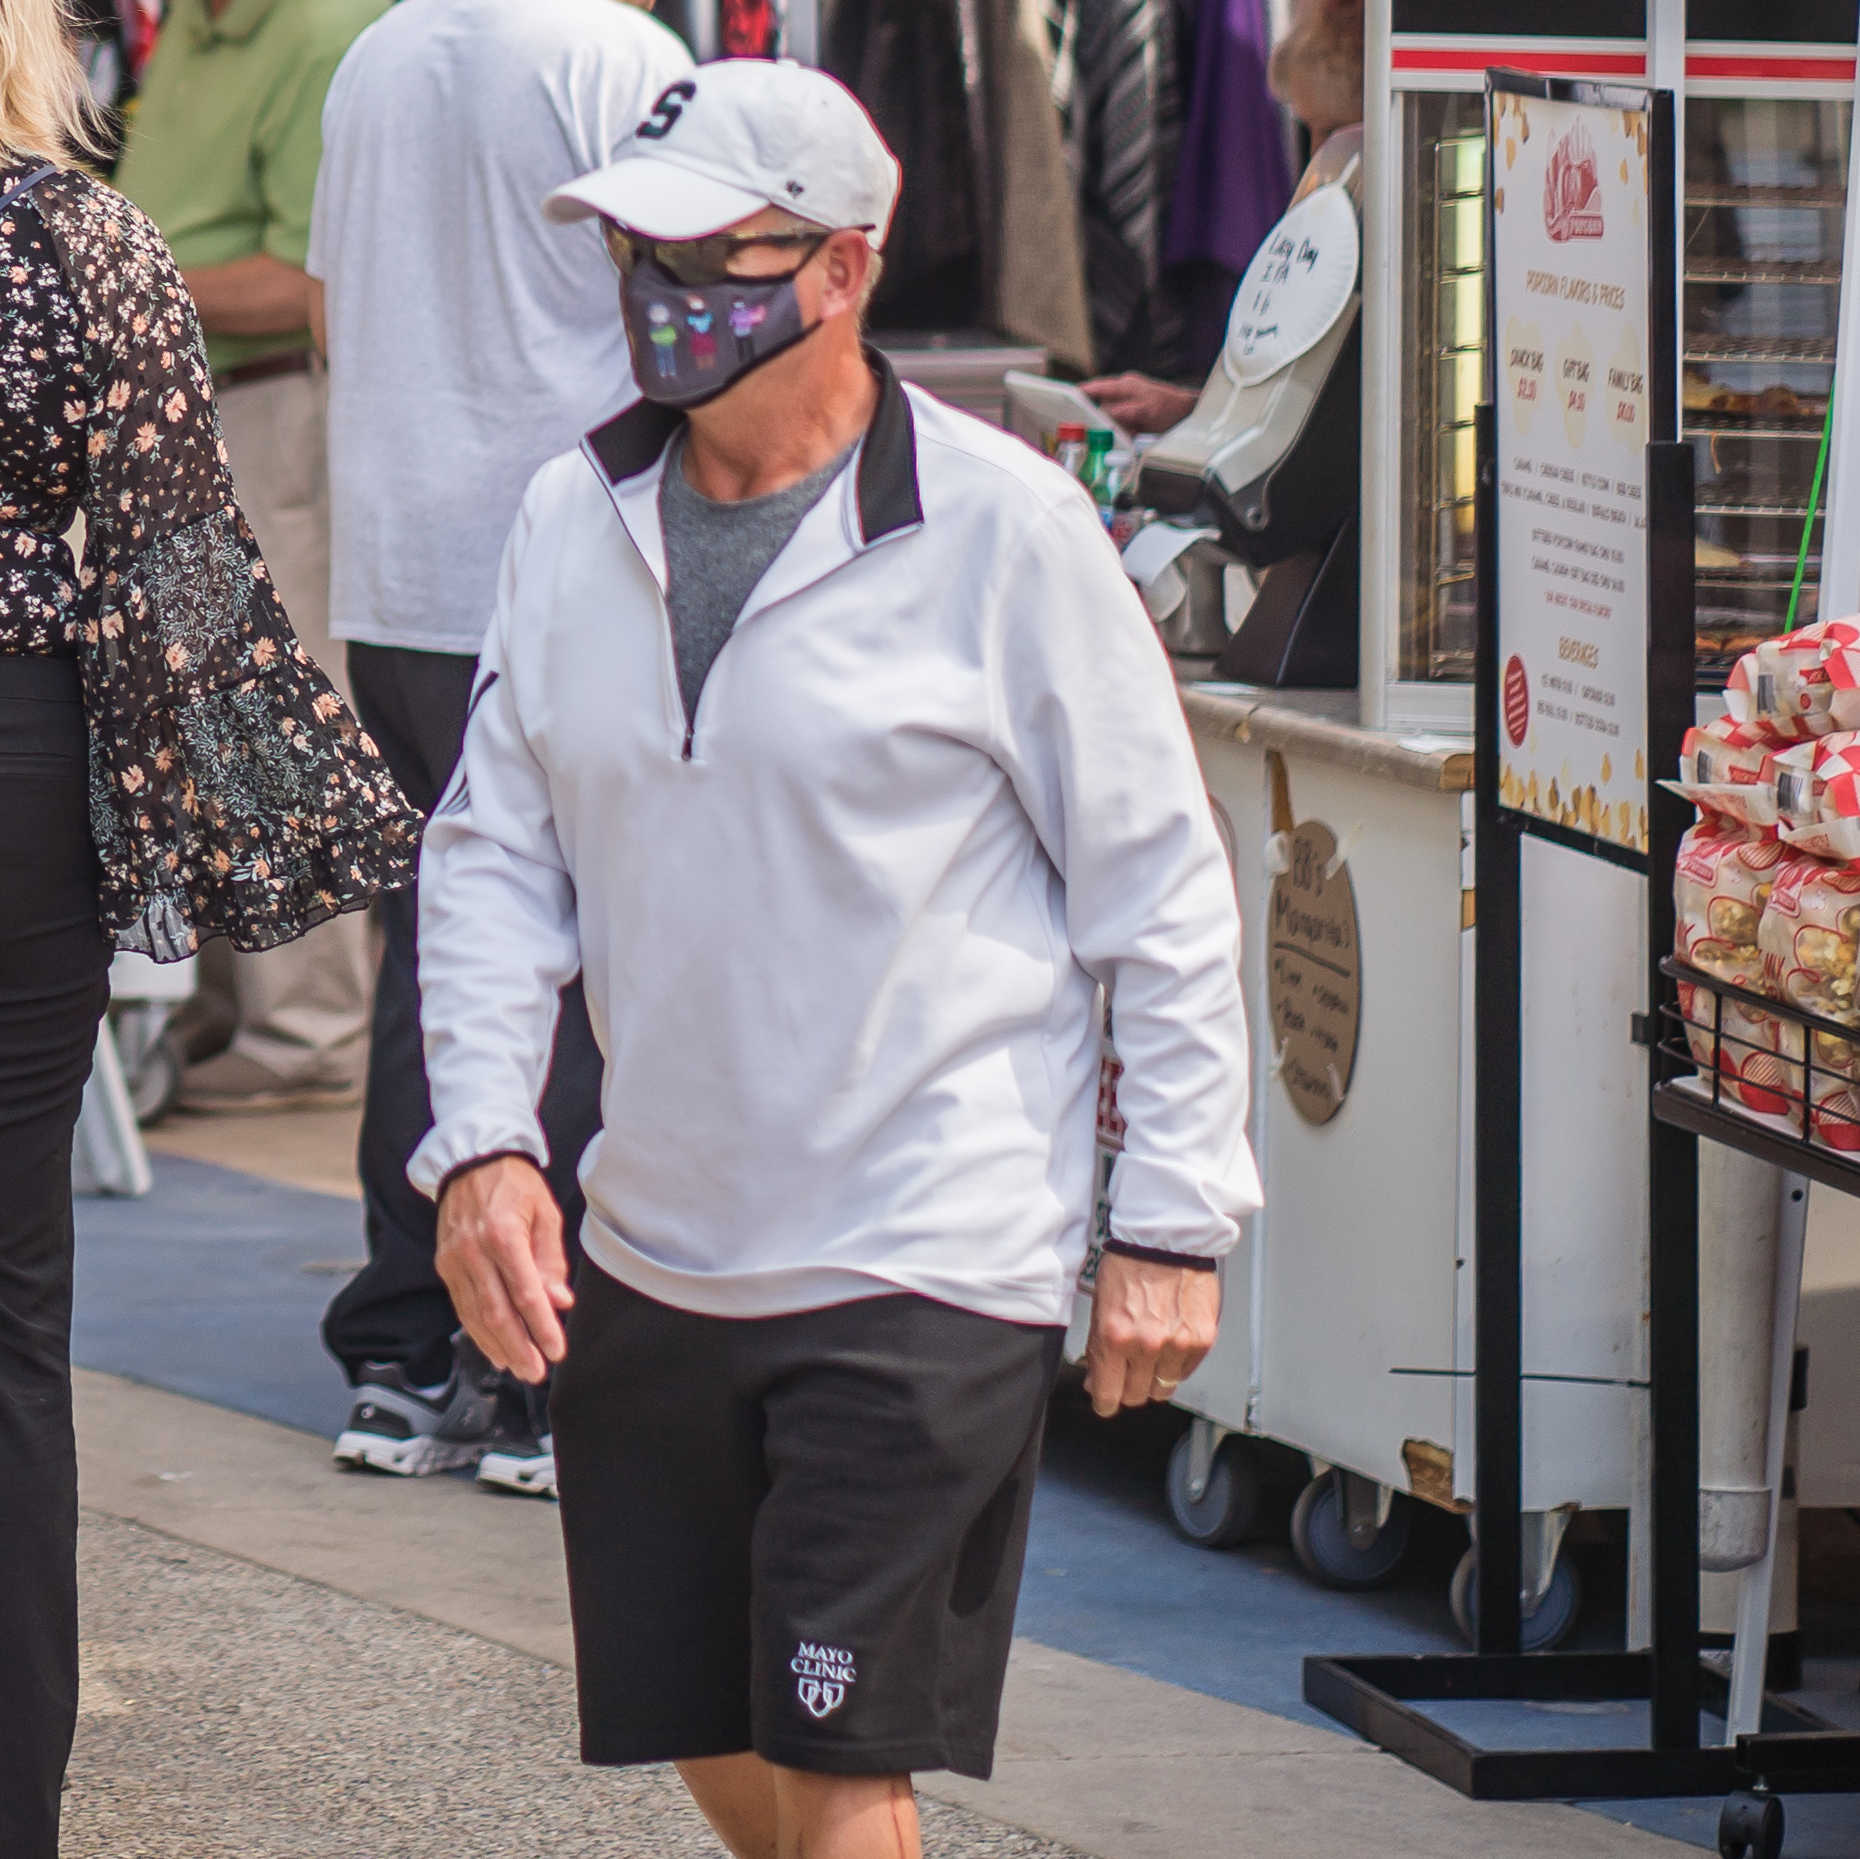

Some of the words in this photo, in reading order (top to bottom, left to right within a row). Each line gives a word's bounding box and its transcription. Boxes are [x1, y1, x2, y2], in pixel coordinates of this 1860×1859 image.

[635, 80, 697, 140] S
[798, 1640, 853, 1665] MAYO
[790, 1657, 857, 1683] CLINIC
